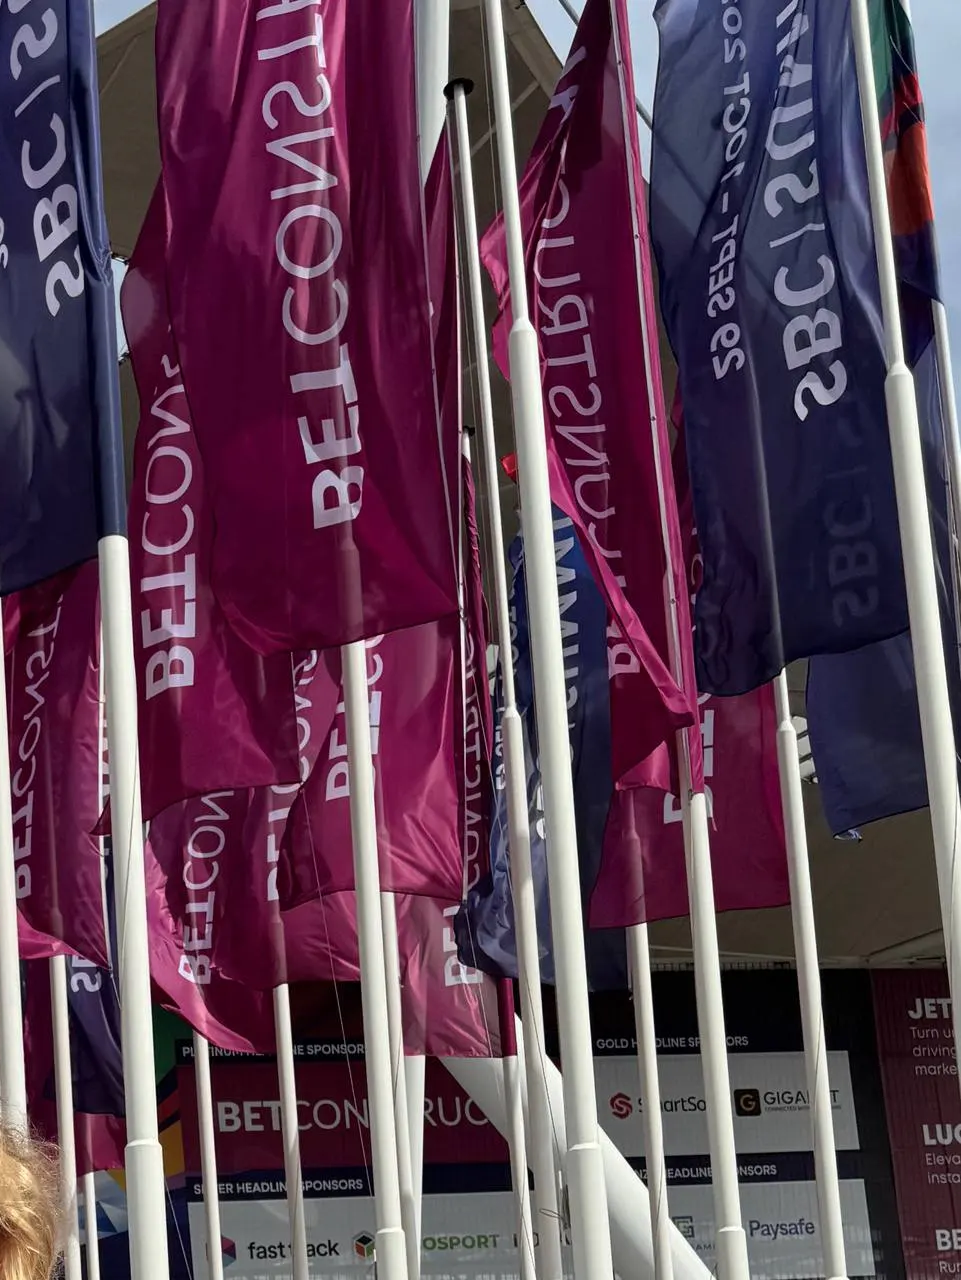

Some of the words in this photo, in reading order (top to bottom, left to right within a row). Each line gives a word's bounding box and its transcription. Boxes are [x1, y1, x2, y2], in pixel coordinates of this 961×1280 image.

[909, 1026, 939, 1039] Turn
[306, 1043, 368, 1056] SPONSOR
[596, 1037, 629, 1049] GOLD
[914, 1063, 957, 1076] marke
[925, 1152, 961, 1166] Eleva
[665, 1166, 713, 1180] EADLINE
[927, 1171, 961, 1185] insta
[236, 1180, 288, 1194] HEADLIN
[748, 1217, 816, 1241] Paysafe
[422, 1233, 500, 1251] OSPORT
[247, 1241, 286, 1260] fast
